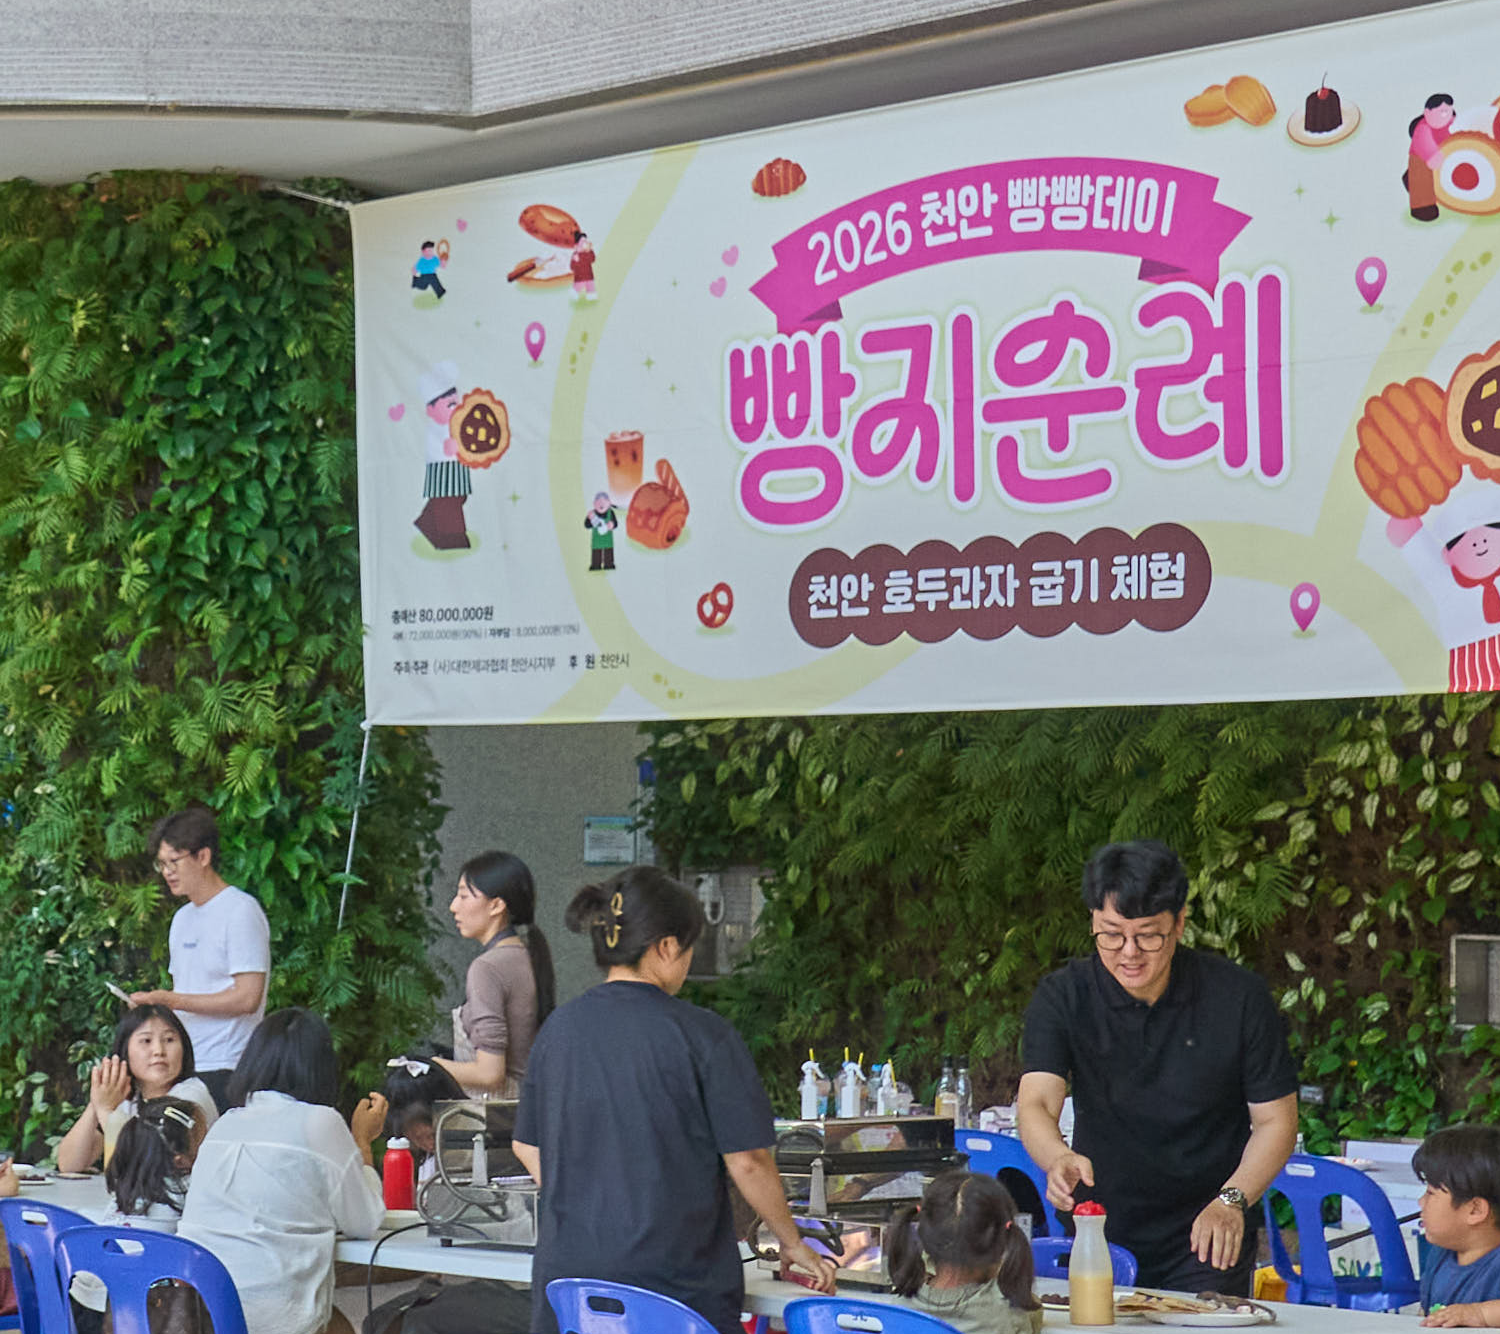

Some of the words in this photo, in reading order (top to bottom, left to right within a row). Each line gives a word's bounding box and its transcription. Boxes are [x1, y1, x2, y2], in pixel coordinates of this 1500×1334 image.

[807, 202, 913, 285] 2026
[919, 181, 998, 248] 천안
[1007, 175, 1178, 237] 빵빵데이
[729, 274, 1284, 526] 빵지순례
[808, 573, 875, 619] 천안
[882, 563, 1020, 614] 호두과자
[1029, 557, 1100, 608] 굽기
[1110, 551, 1187, 602] 체험
[600, 653, 630, 668] 천안시
